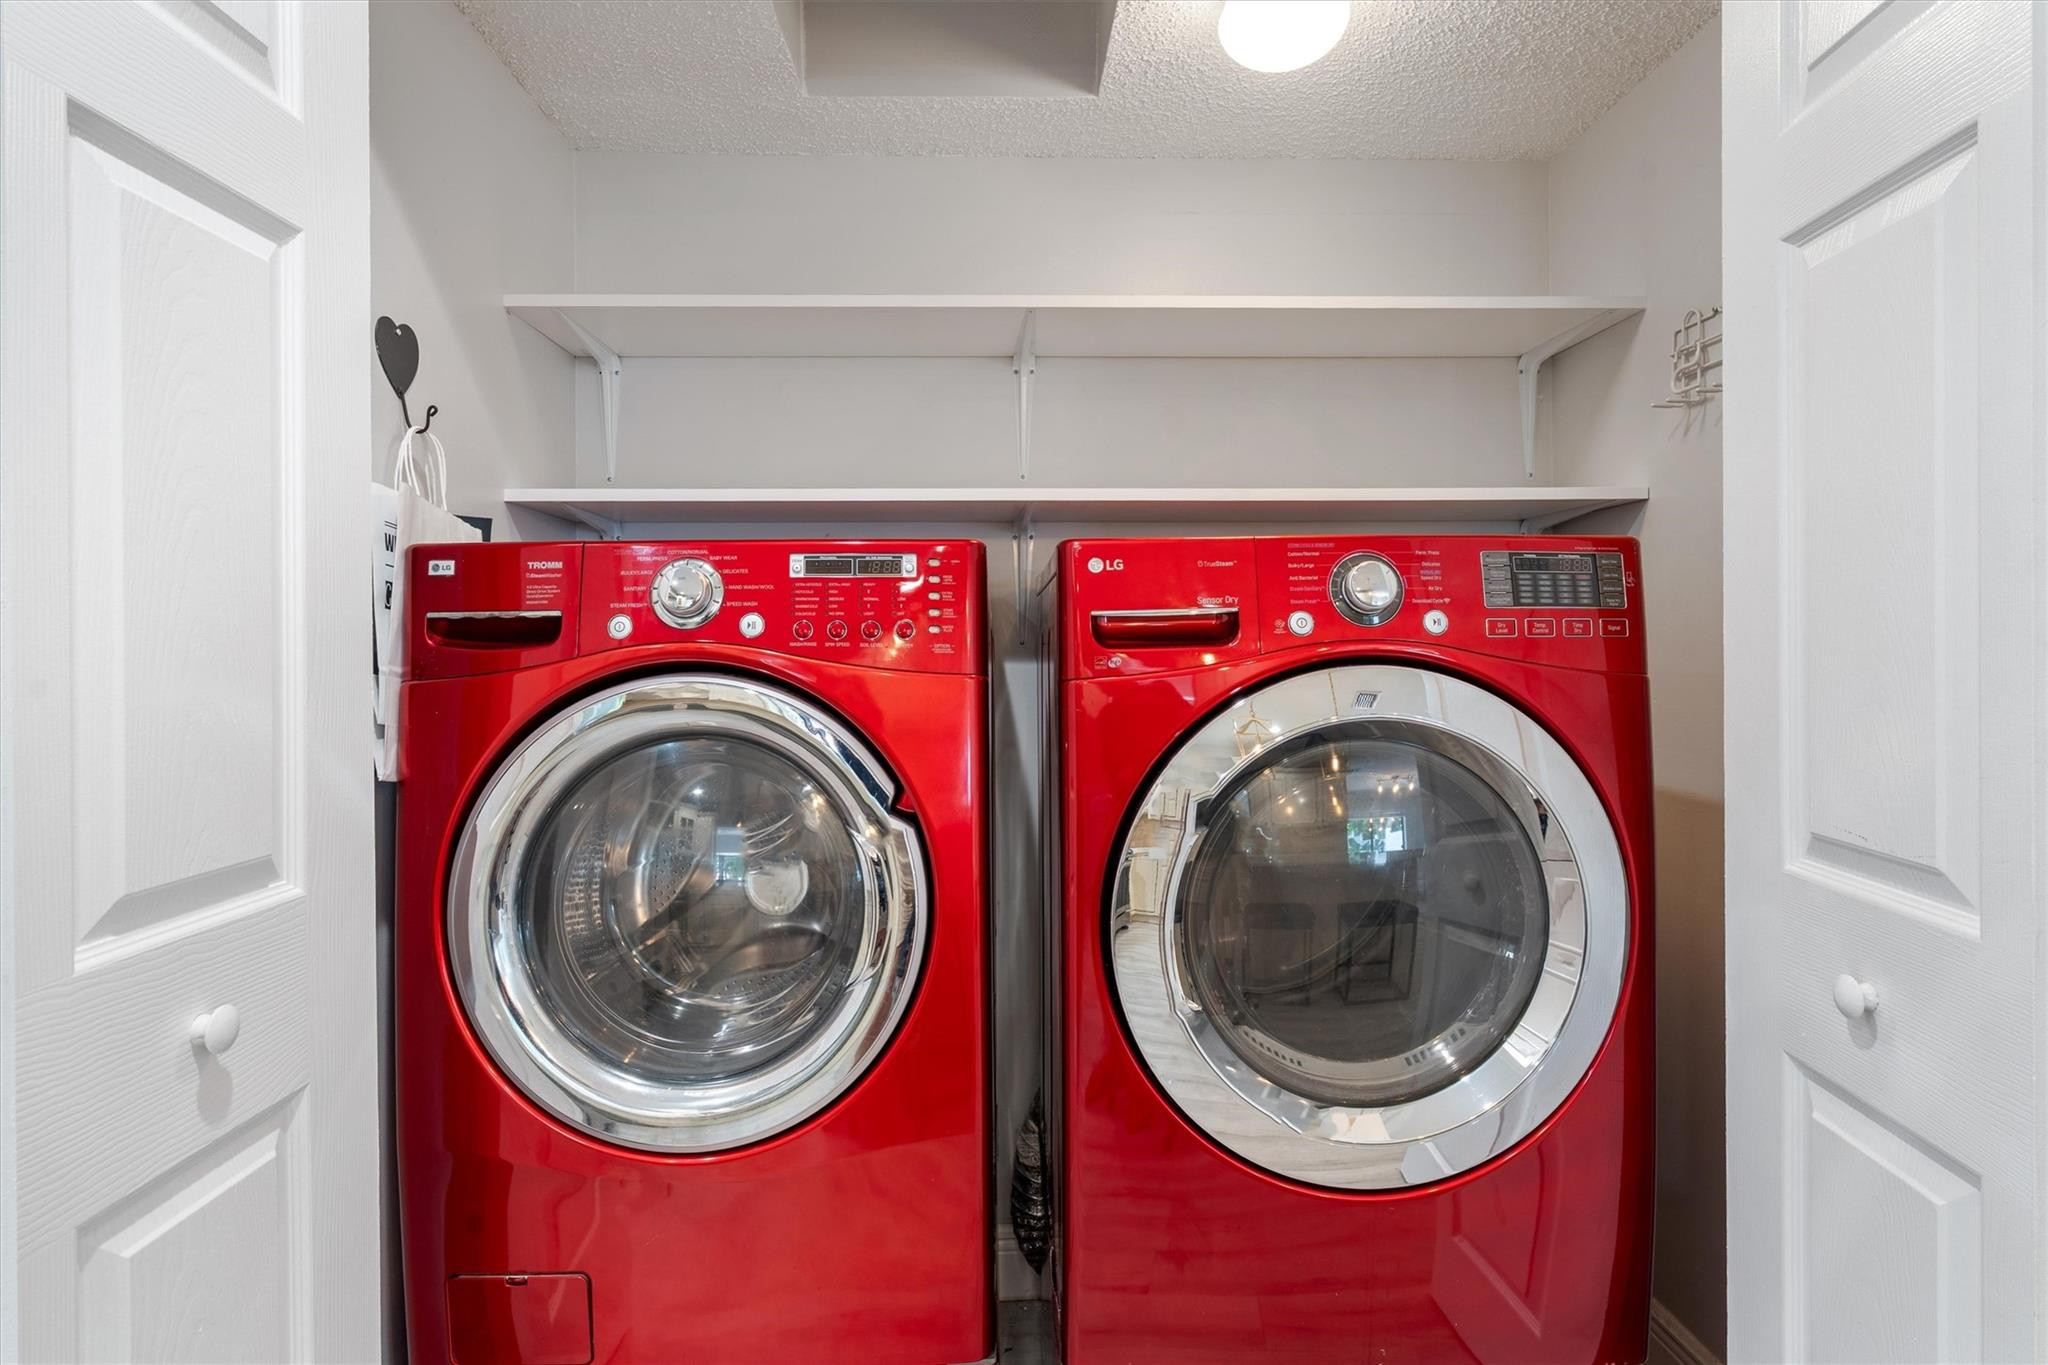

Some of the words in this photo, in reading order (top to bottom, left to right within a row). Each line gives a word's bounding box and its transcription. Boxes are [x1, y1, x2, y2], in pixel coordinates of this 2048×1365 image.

[527, 561, 563, 569] TROMM
[1106, 559, 1124, 571] LG
[1197, 596, 1223, 605] Sensor
[1225, 595, 1239, 606] Dry
